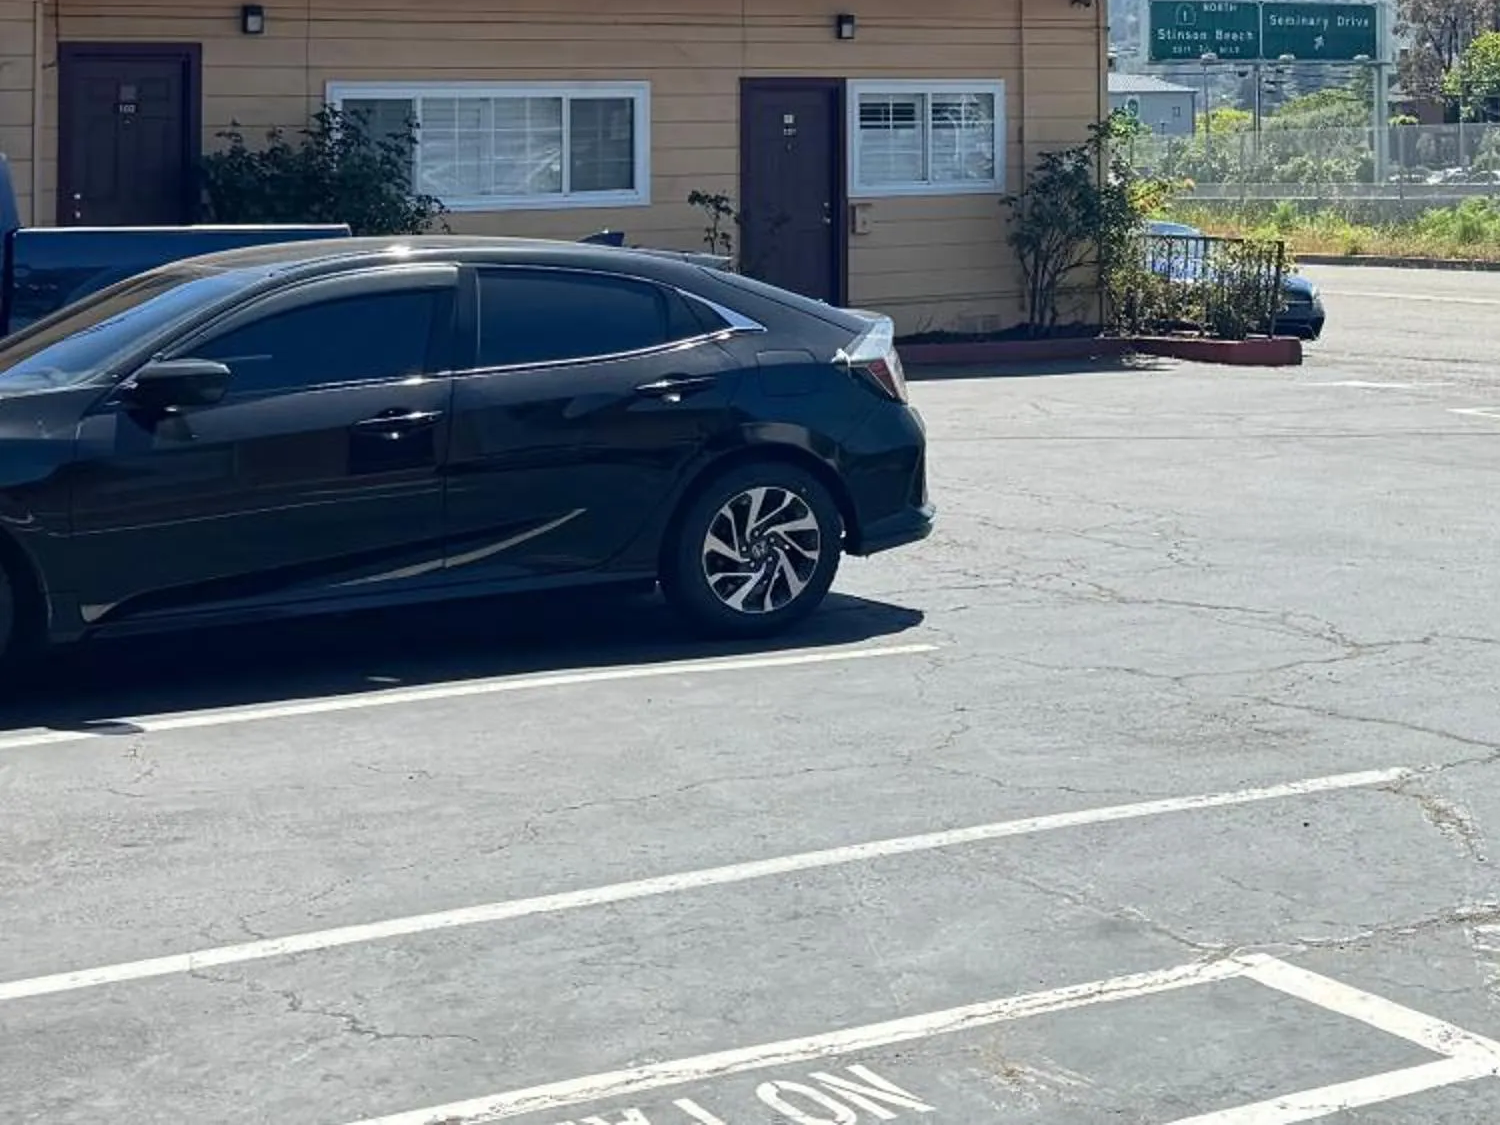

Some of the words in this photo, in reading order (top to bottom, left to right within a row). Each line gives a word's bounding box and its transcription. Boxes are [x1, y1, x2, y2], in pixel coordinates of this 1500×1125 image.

[1203, 2, 1237, 12] NORTH
[1269, 14, 1329, 31] Seminary
[1337, 14, 1369, 28] Drive
[1157, 28, 1207, 40] Stinson
[1215, 28, 1254, 41] Beach
